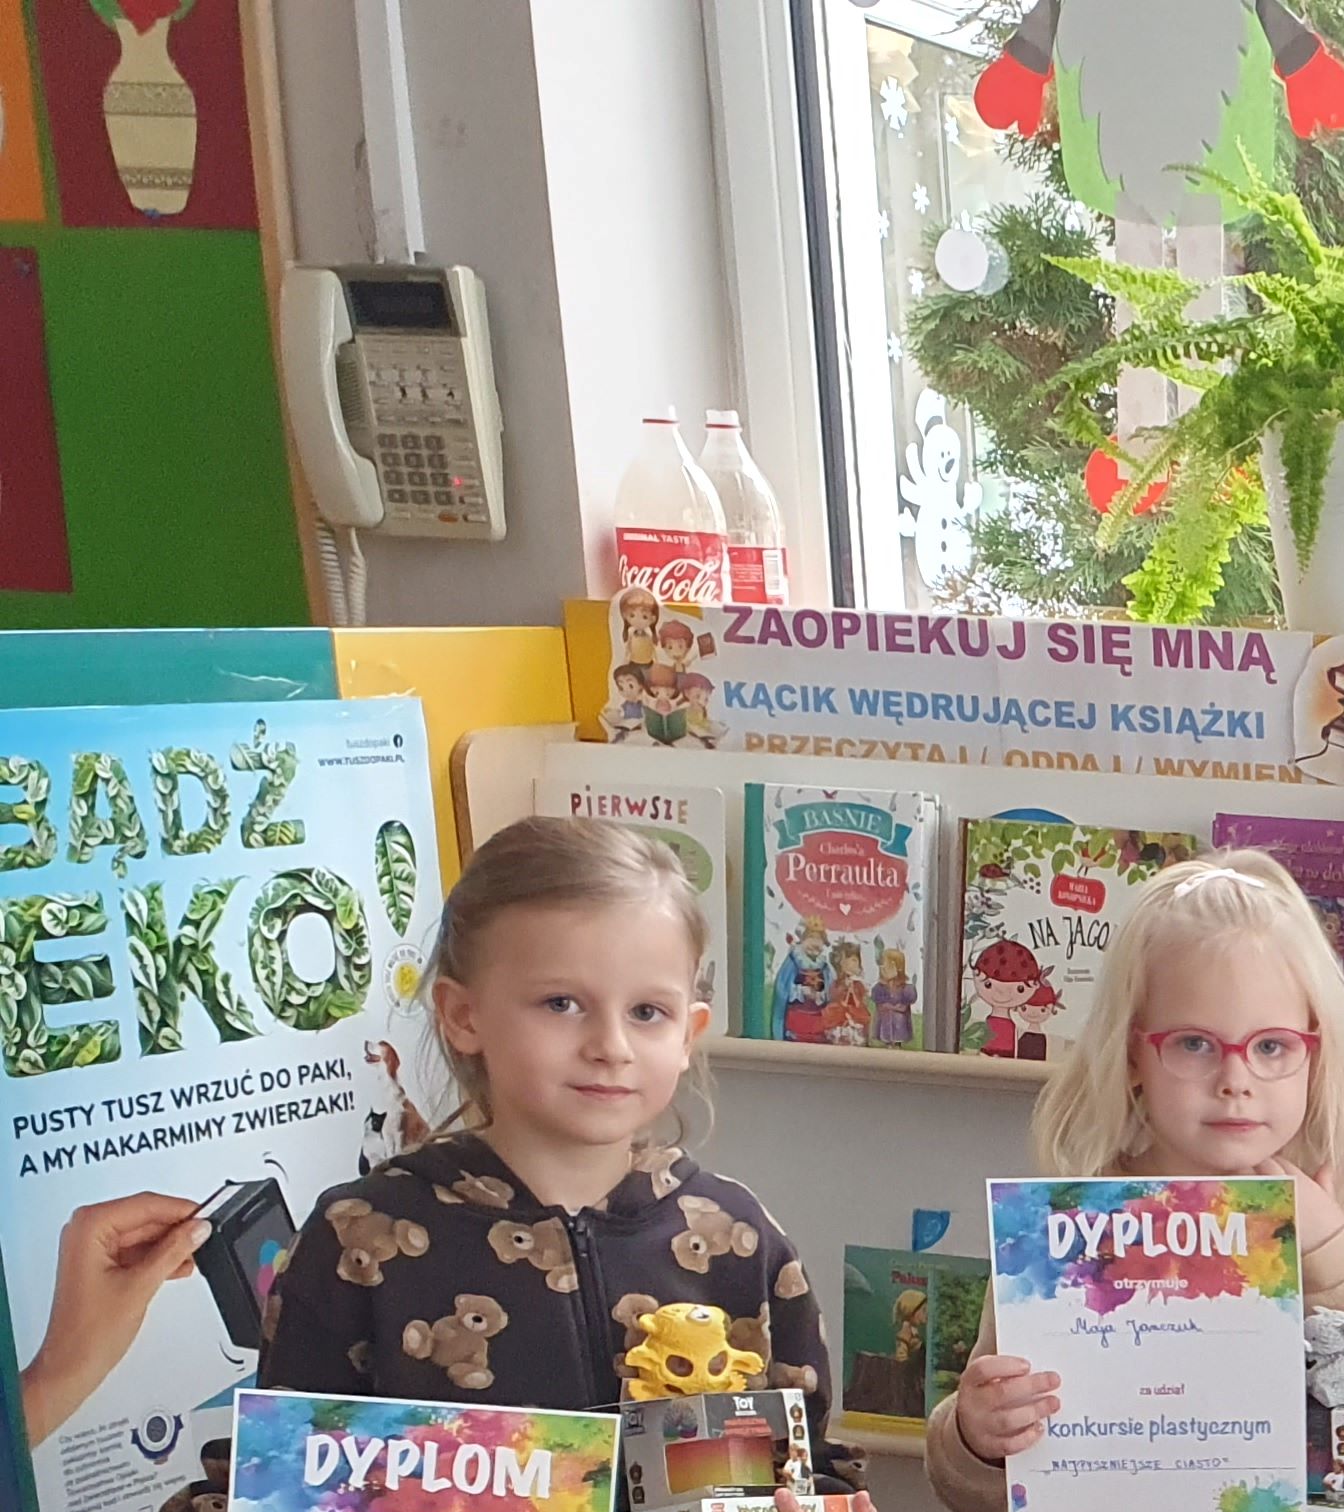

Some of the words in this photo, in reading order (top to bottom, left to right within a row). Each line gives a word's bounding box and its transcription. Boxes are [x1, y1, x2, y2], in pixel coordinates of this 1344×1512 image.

[662, 535, 690, 545] TASTE
[721, 605, 1027, 661] ZAOPIEKUJ
[1046, 623, 1133, 677] SIĘ
[1152, 628, 1279, 685] MNĄ
[723, 680, 838, 726] KĄCIK
[850, 687, 1097, 732] WĘDRUJĄCEJ
[1110, 699, 1266, 746] KSIĄŻKI
[803, 807, 882, 834] BAŚNIE
[785, 852, 900, 888] Perraulta
[0, 820, 418, 1078] EKO!
[1028, 916, 1061, 950] NA
[12, 1103, 95, 1140] PUSTY
[101, 1091, 165, 1124] TUSZ
[170, 1068, 254, 1110] WRZUĆ
[259, 1069, 292, 1095] DO
[297, 1057, 353, 1087] PAKI,
[18, 1153, 40, 1178] A
[43, 1145, 78, 1173] MY
[83, 1115, 227, 1166] NAKARMIMY
[232, 1089, 355, 1134] ZWIERZAKI!
[1048, 1211, 1249, 1260] DYPLOM
[1113, 1277, 1189, 1291] otrzymuje
[1070, 1316, 1117, 1348] Maja
[732, 1396, 754, 1411] TOY
[1138, 1386, 1151, 1395] za
[1154, 1383, 1185, 1396] udział
[1046, 1415, 1144, 1438] konkursie
[1150, 1414, 1272, 1443] plastycznym
[303, 1432, 553, 1500] DYPLOM
